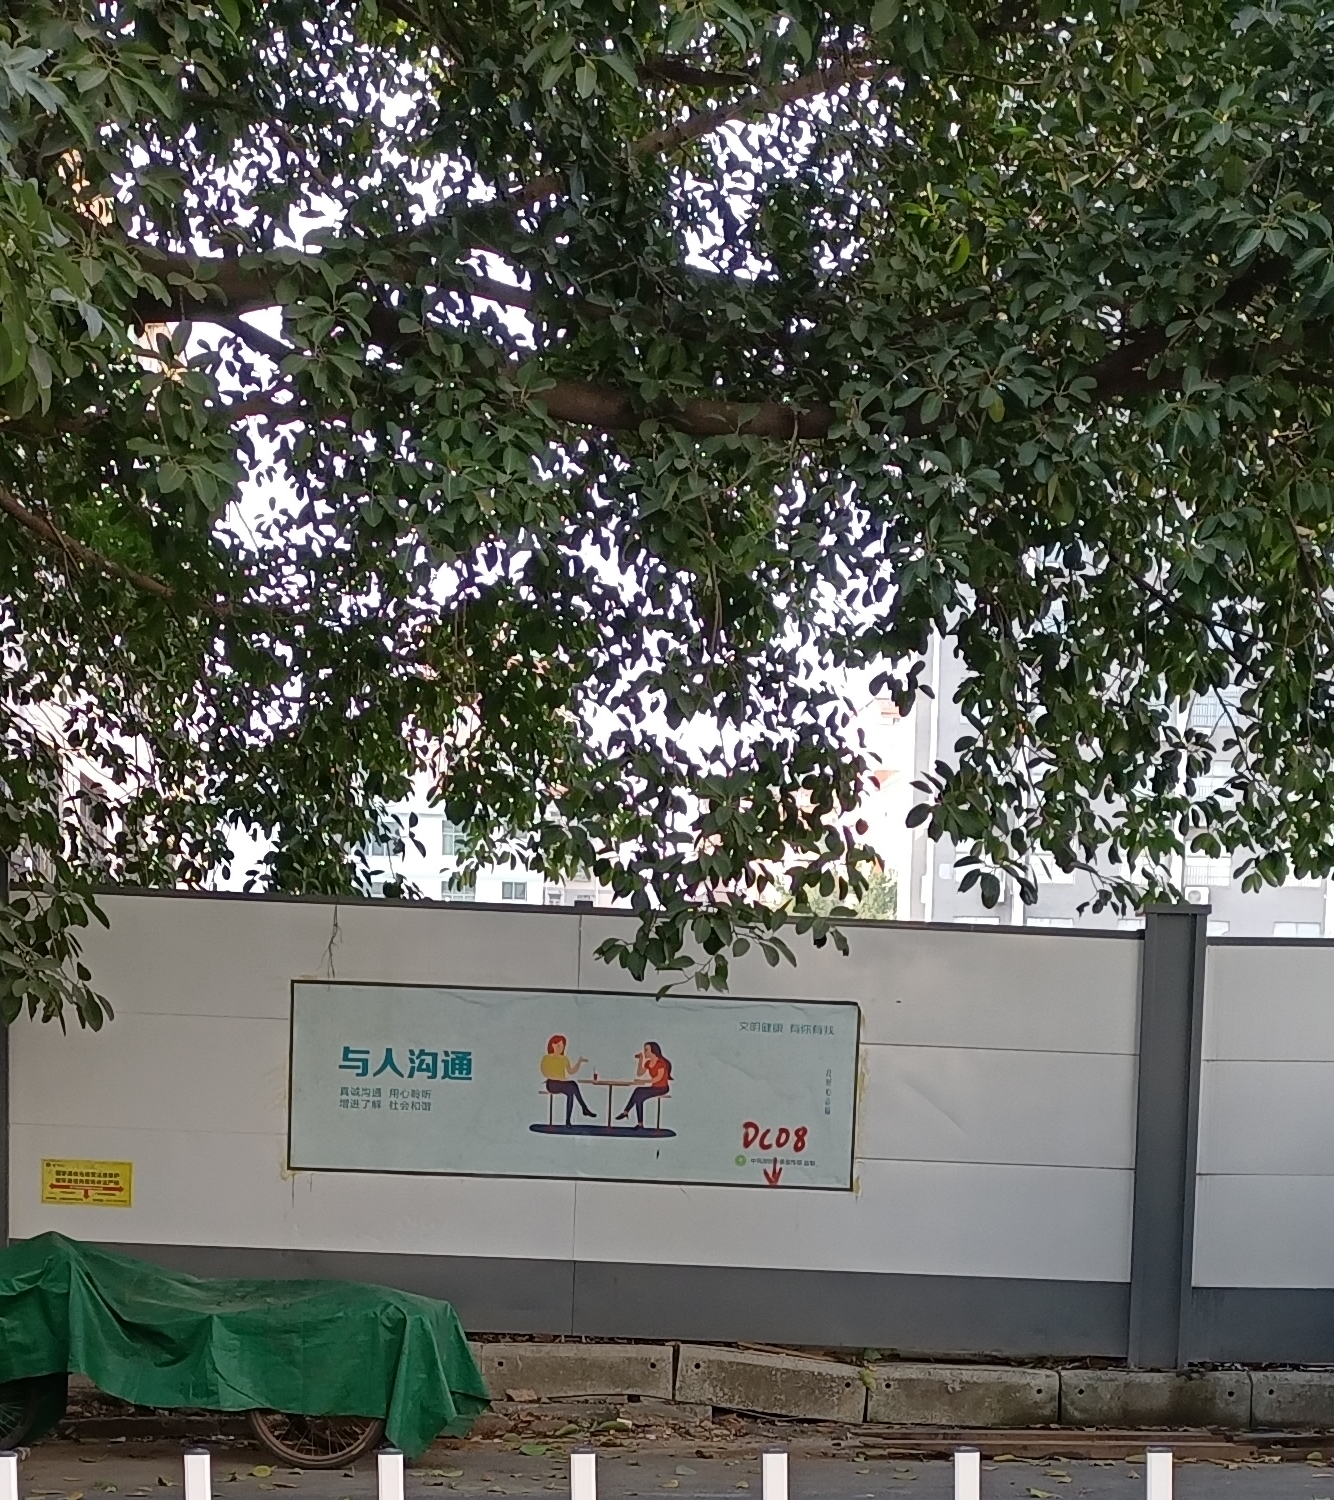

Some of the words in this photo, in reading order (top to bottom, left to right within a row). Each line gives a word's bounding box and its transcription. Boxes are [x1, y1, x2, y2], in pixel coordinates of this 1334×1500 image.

[338, 1046, 473, 1081] 与人沟通
[340, 1086, 383, 1098] 真诚沟通
[742, 1121, 808, 1153] DC08
